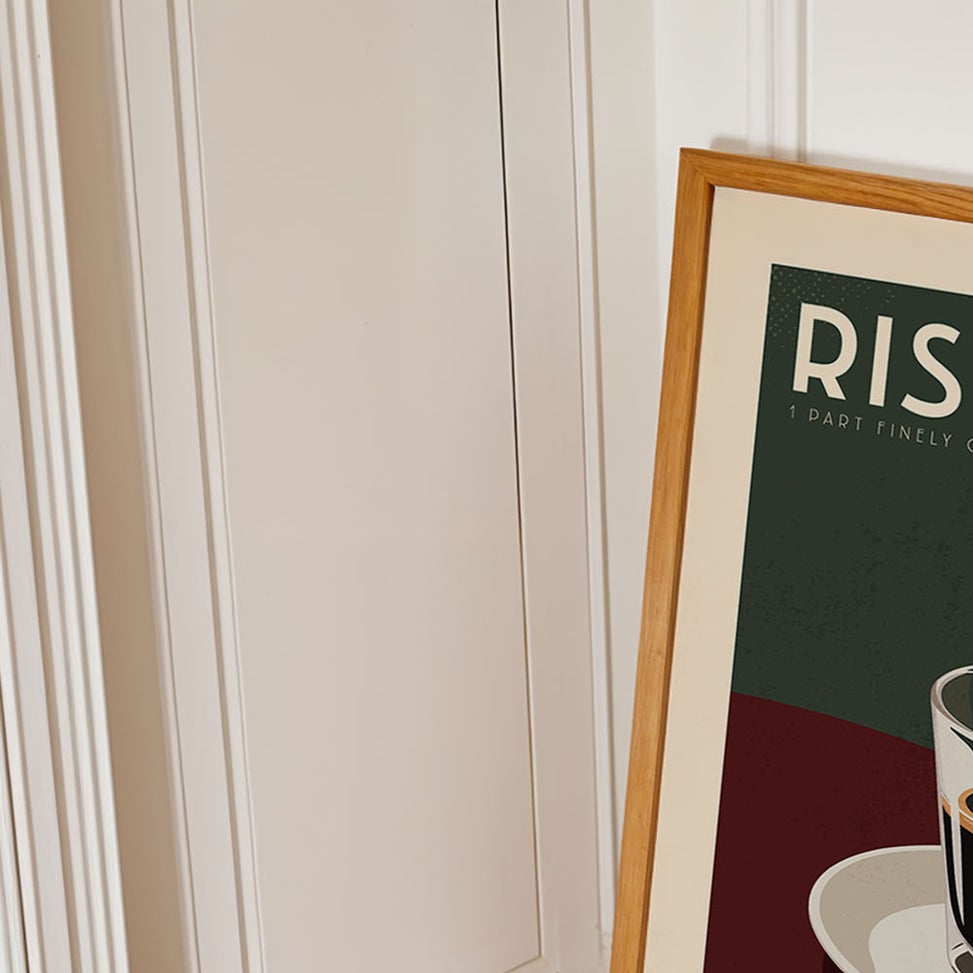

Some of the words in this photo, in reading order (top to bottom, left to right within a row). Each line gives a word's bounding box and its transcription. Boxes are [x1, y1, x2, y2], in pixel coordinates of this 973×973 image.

[788, 404, 796, 419] 1
[808, 407, 864, 432] PART
[876, 420, 952, 448] FINELY
